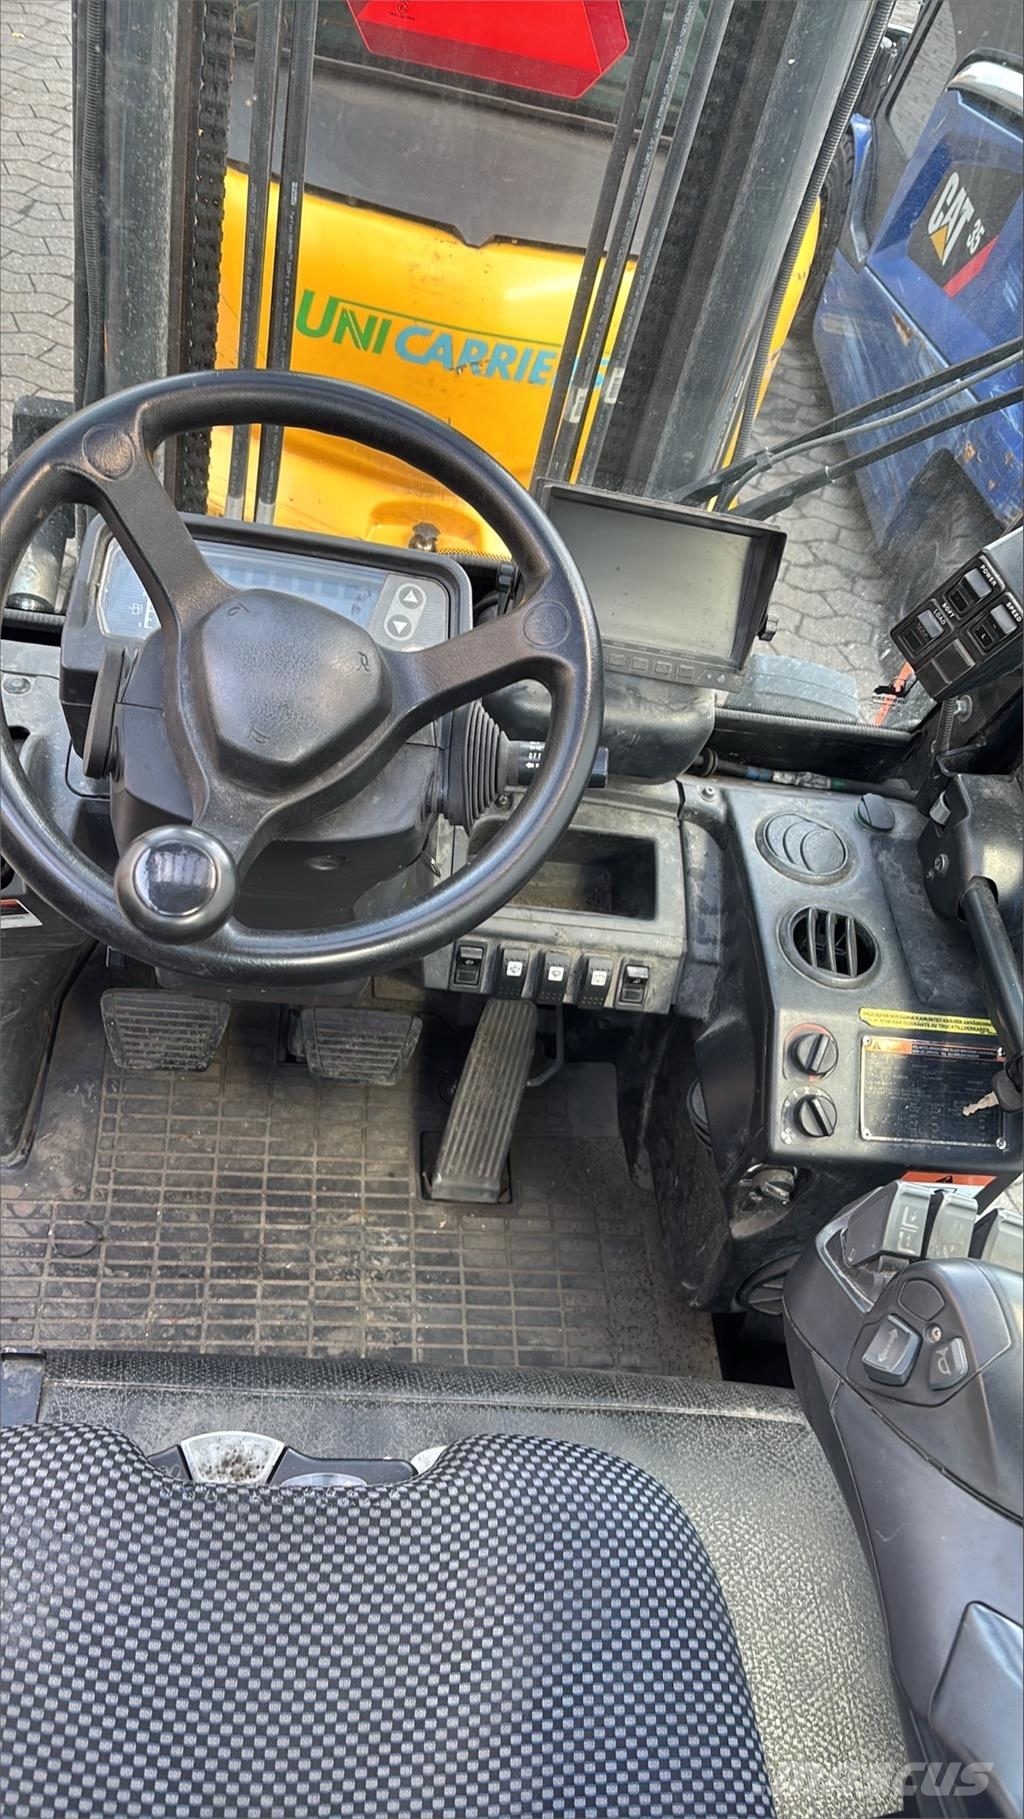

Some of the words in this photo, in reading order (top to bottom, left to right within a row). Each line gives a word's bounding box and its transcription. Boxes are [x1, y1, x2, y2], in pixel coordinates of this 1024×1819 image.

[928, 172, 975, 266] CAT
[966, 218, 985, 254] 35
[980, 564, 997, 586] POWER
[933, 609, 946, 625] LOAD
[941, 602, 955, 618] SOFT
[1005, 602, 1022, 622] SPEED
